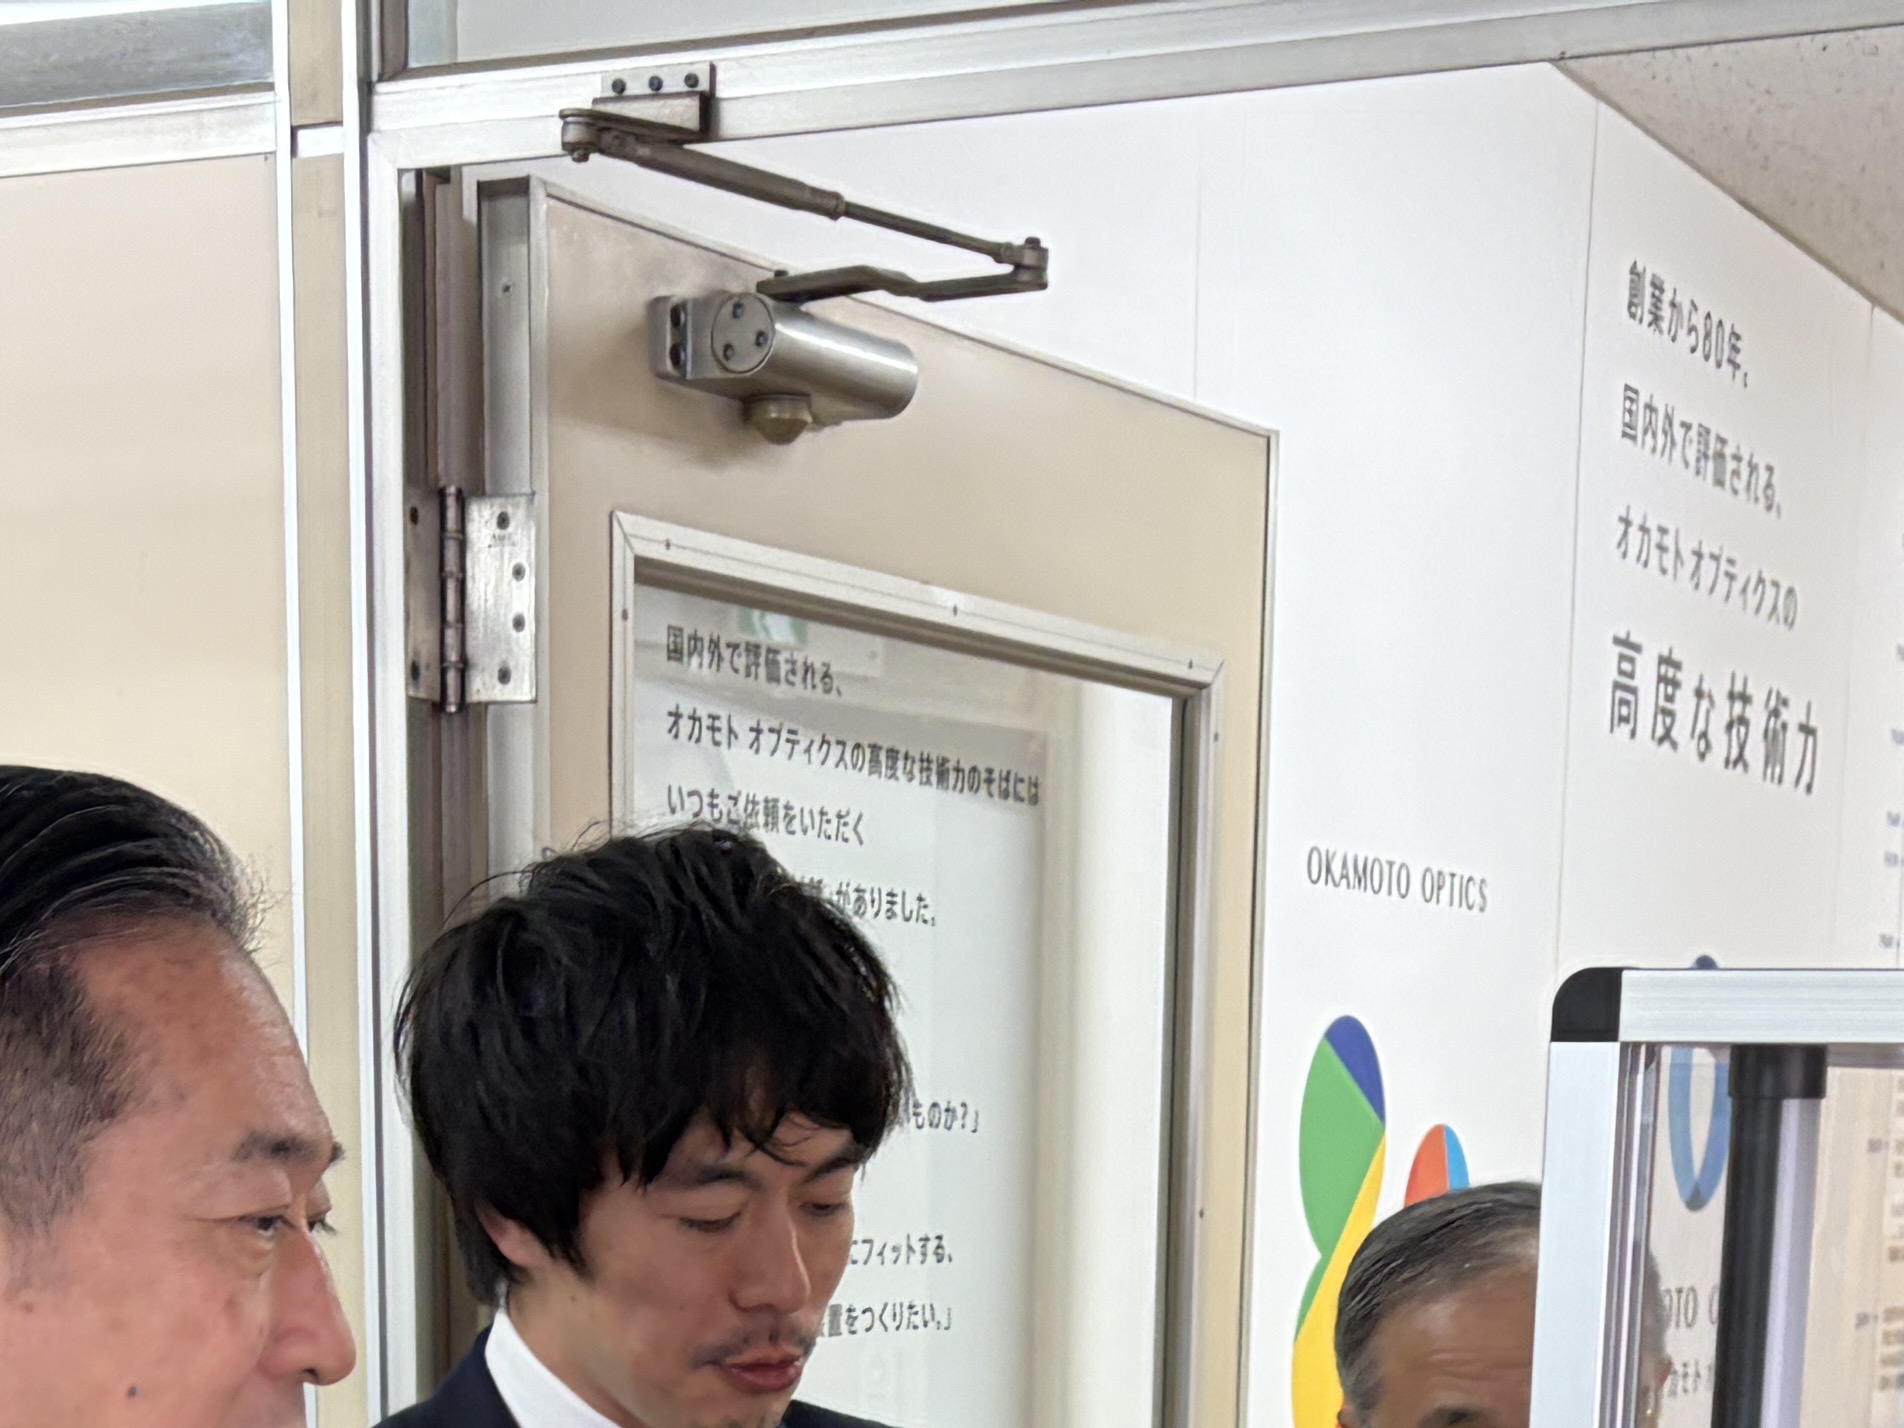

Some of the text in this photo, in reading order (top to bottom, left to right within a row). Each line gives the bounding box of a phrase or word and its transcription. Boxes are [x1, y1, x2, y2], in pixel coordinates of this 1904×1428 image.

[1621, 383, 1782, 520] 国内外で評価される、
[666, 624, 842, 698] 国内外で評価される、
[1609, 629, 1820, 796] 高度な技術力
[800, 876, 936, 927] がありました。
[1306, 845, 1489, 913] OKAMOTO OPTICS
